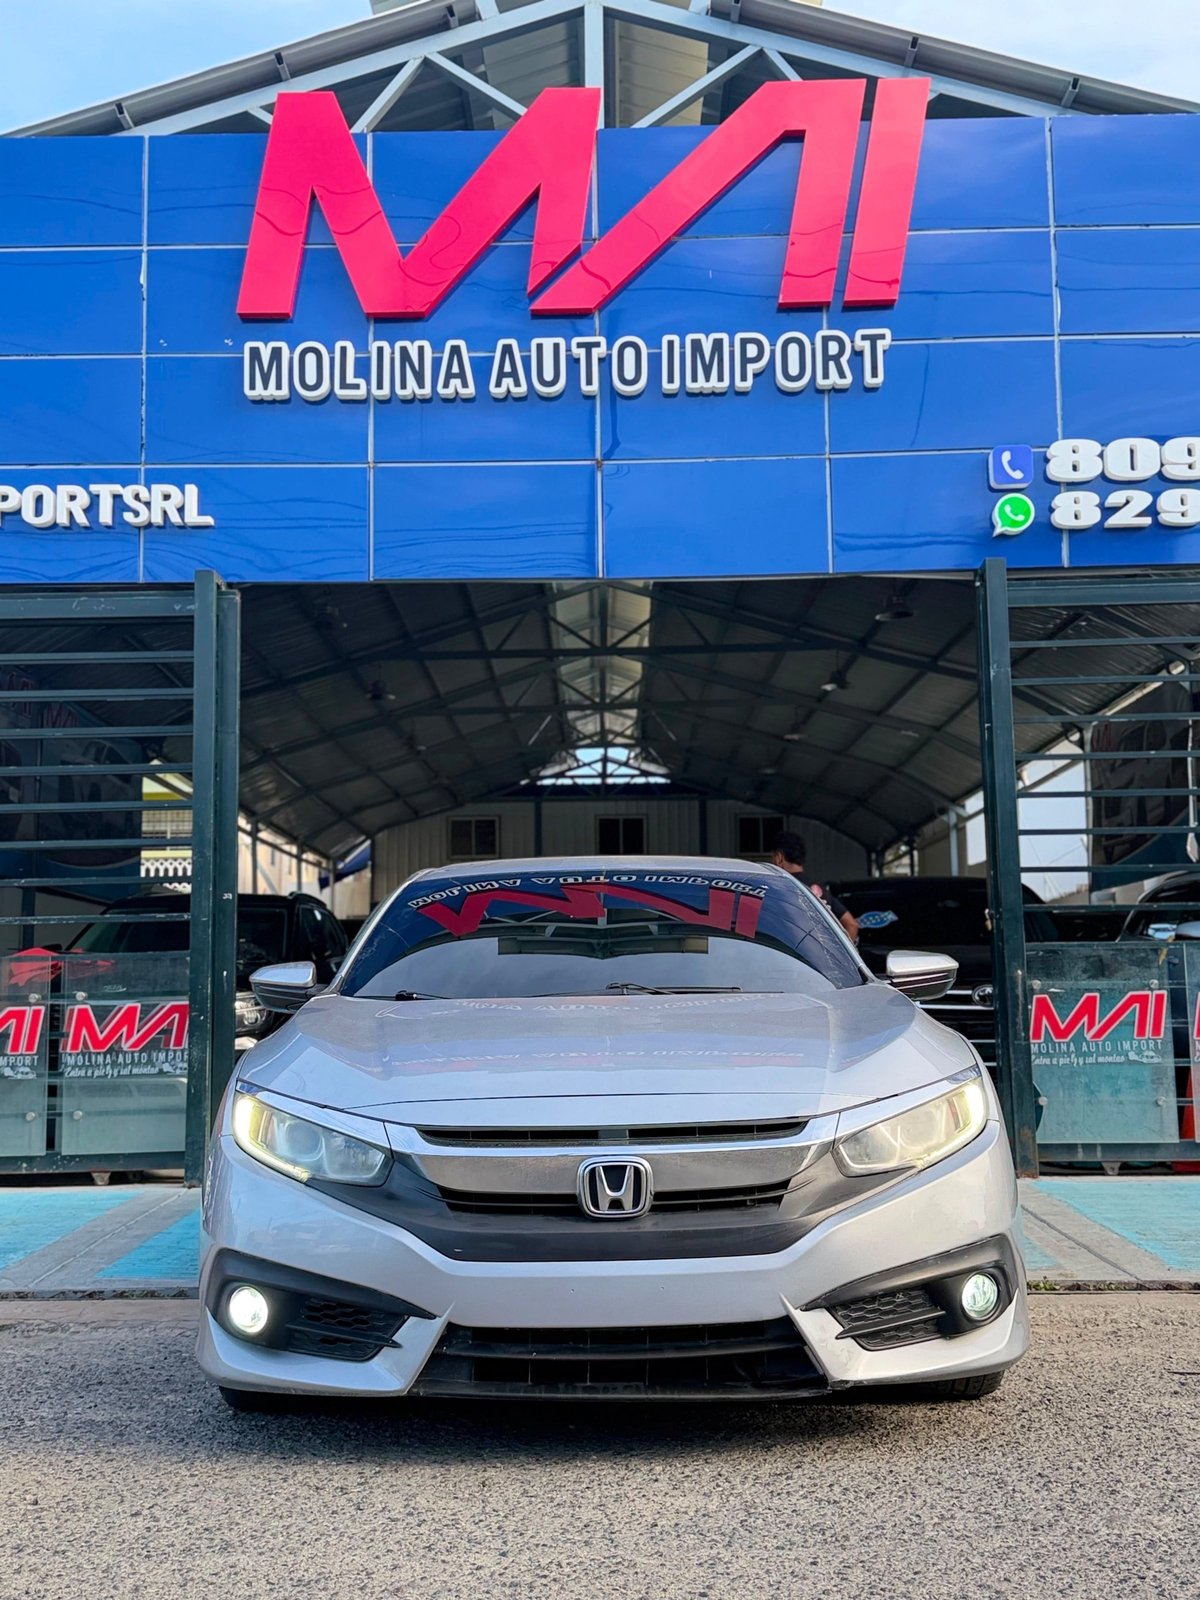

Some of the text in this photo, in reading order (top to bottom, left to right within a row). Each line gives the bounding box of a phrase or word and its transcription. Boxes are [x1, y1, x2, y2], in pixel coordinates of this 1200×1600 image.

[237, 77, 931, 319] MAI
[243, 328, 892, 402] MOLINA AUTO IMPORT
[1046, 436, 1200, 482] 809
[1051, 488, 1200, 529] 829
[66, 1001, 189, 1054] MA
[1030, 989, 1167, 1042] MAI
[67, 1053, 112, 1066] MOLINA
[117, 1052, 148, 1064] AUTO
[1031, 1039, 1163, 1054] MOLINA AUTO IMPORT
